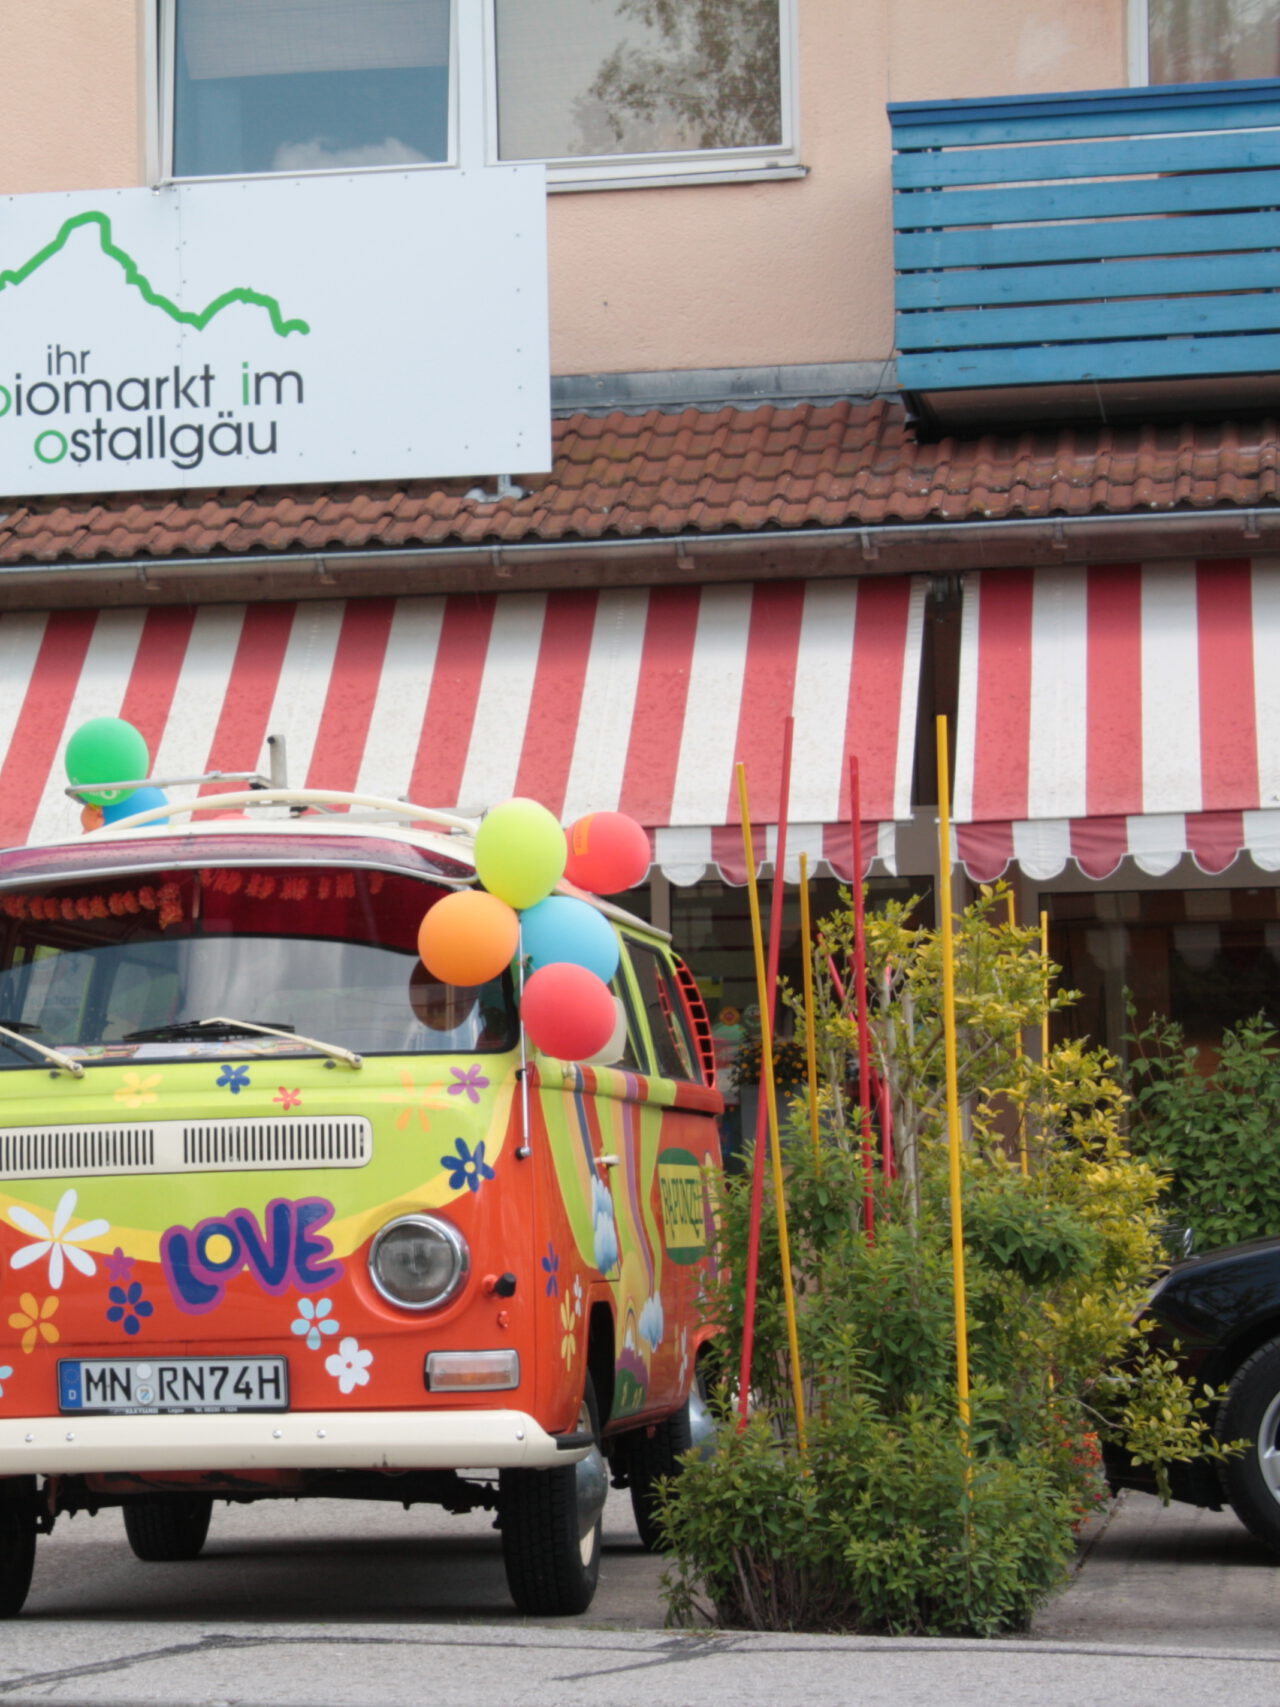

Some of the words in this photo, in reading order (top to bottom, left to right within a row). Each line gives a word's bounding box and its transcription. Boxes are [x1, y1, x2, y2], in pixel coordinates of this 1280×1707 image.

[47, 344, 91, 375] ihr
[242, 361, 304, 406] im
[34, 411, 277, 470] ostallgäu
[163, 1199, 342, 1312] LOVE
[68, 1389, 77, 1400] D
[84, 1366, 133, 1402] MN
[158, 1365, 281, 1402] RN74H
